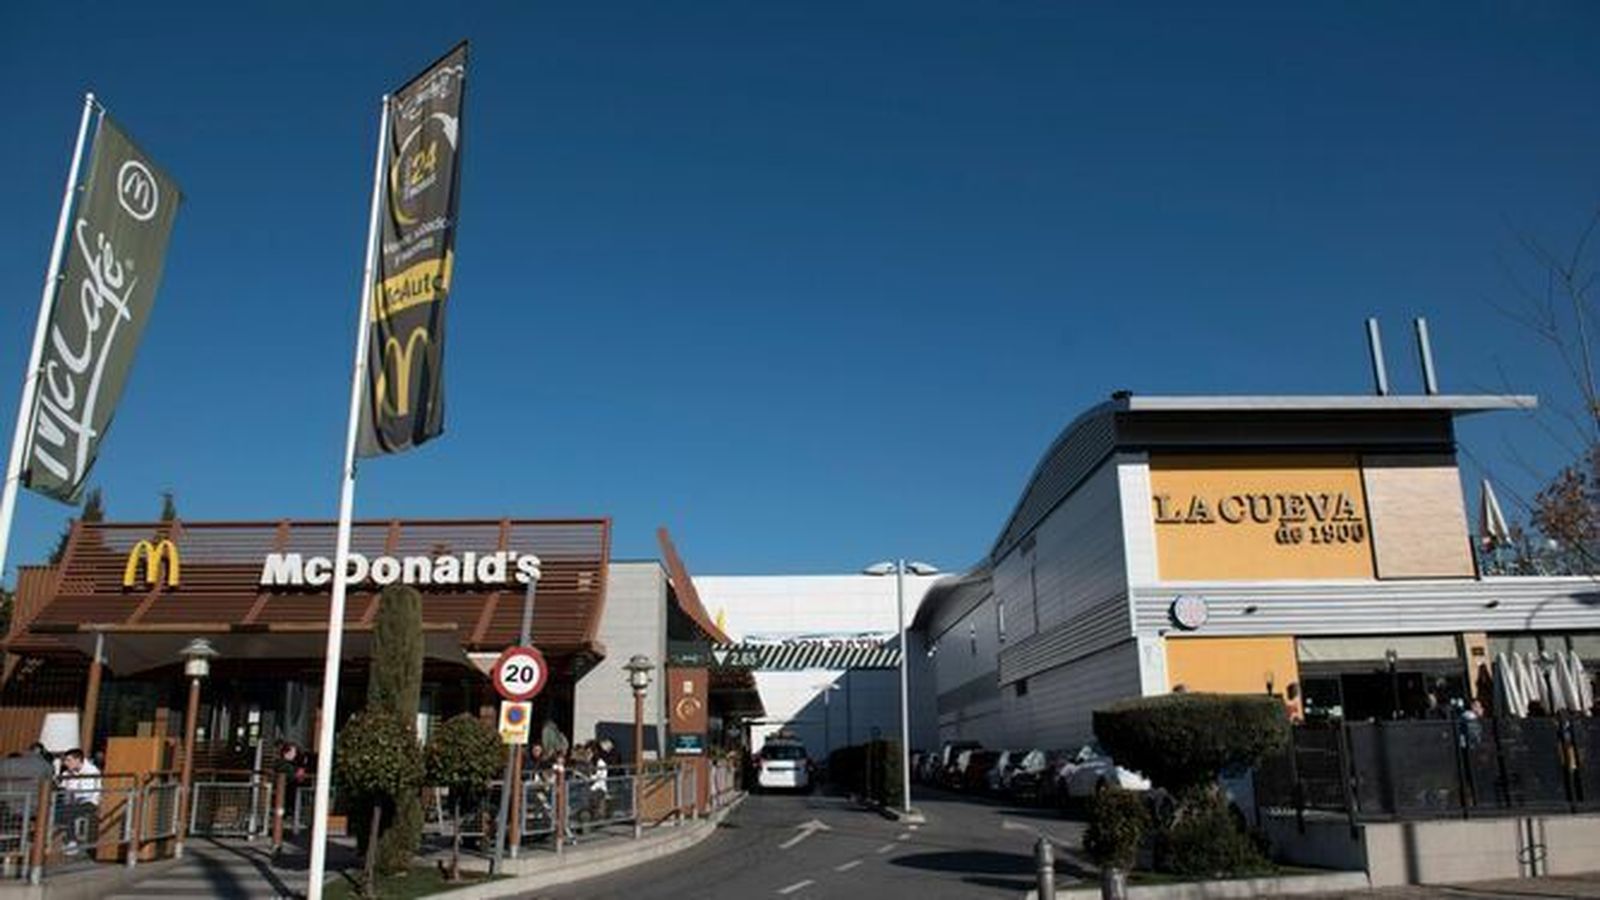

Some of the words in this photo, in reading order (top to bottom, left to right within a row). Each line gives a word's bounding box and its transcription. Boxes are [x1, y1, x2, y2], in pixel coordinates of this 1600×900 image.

[1274, 520, 1303, 545] de
[260, 551, 542, 585] McDonald's
[504, 664, 535, 684] 20
